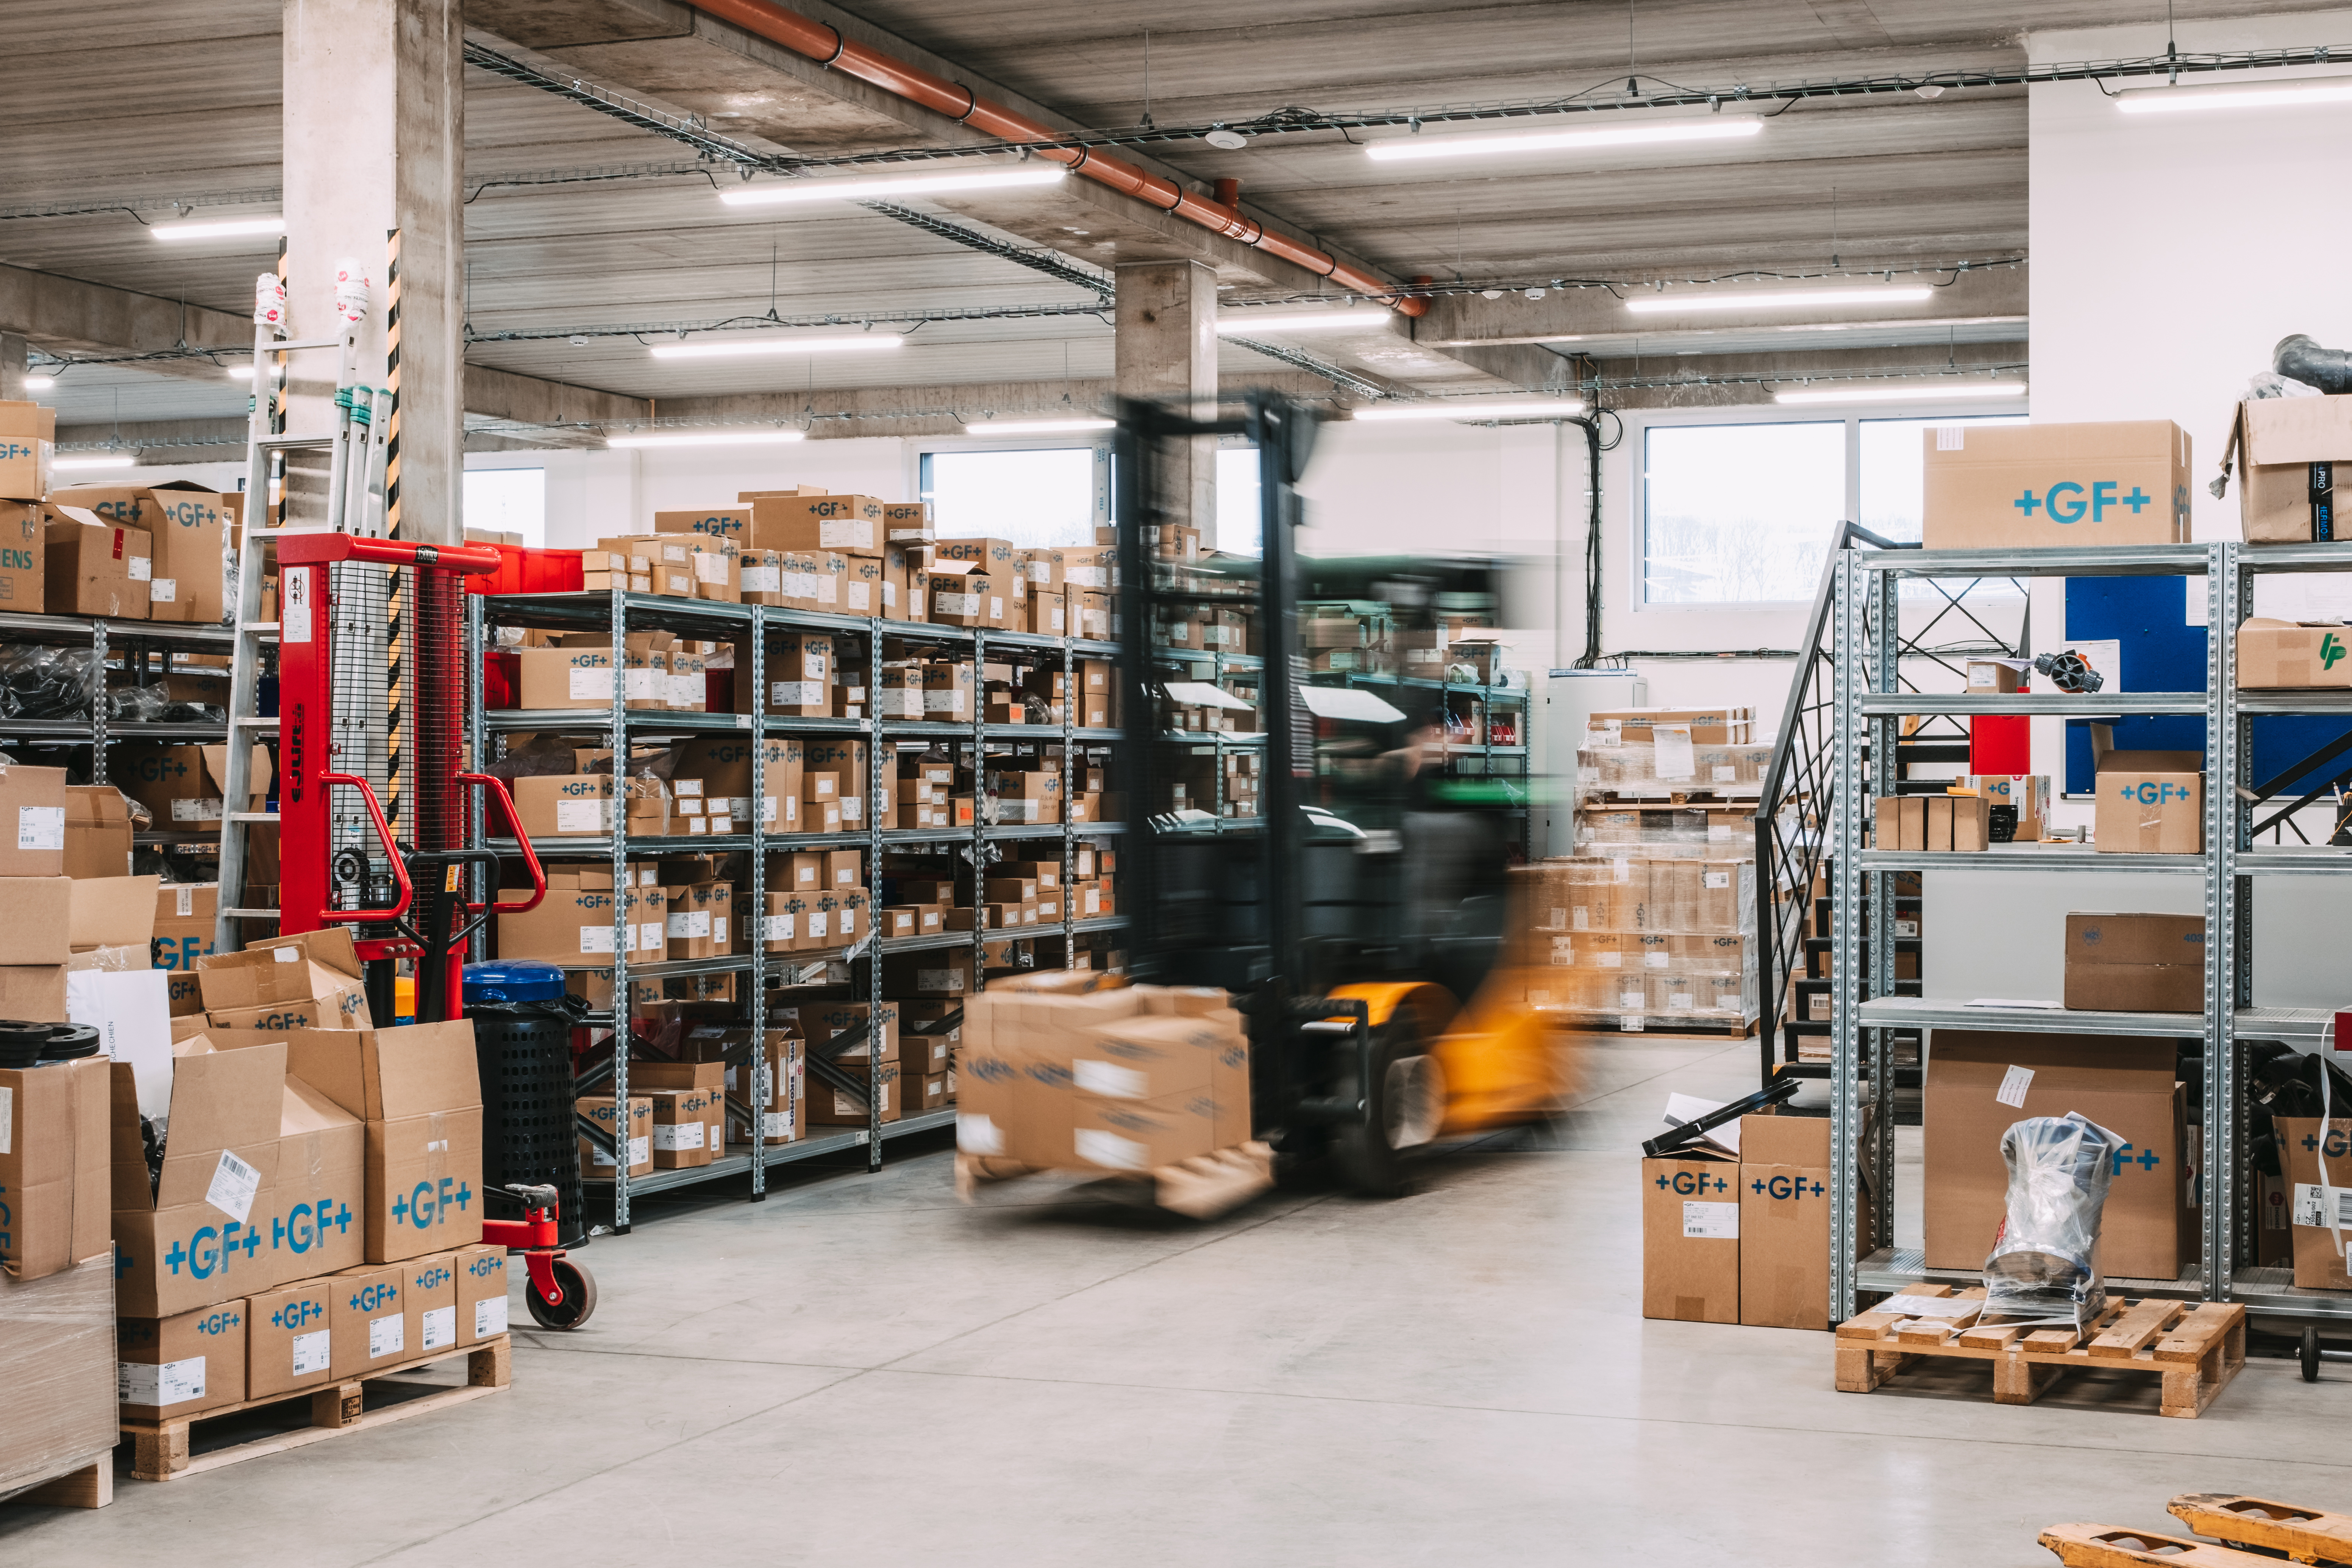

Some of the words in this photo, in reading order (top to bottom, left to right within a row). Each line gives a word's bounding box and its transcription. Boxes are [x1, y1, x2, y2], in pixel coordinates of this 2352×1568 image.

[0, 444, 31, 459] GF+
[2014, 481, 2151, 524] +GF+
[166, 502, 216, 527] +GF+
[863, 504, 881, 518] +GF+
[887, 508, 918, 519] +GF+
[693, 517, 742, 535] +GF+
[720, 545, 739, 561] +GF+
[942, 545, 981, 559] +GF+
[992, 546, 1011, 561] +GF+
[1053, 554, 1063, 562] +GF+
[0, 549, 33, 570] ENS
[740, 556, 757, 564] F+
[763, 556, 779, 568] +GF+
[783, 558, 799, 570] +GF+
[800, 560, 817, 572] +GF+
[826, 559, 845, 573] +GF+
[1013, 559, 1025, 573] +GF+
[859, 565, 879, 579] +GF+
[929, 577, 959, 591] GF+
[973, 581, 990, 593] +GF+
[804, 640, 829, 654] +GF+
[571, 654, 607, 667] +GF+
[650, 656, 665, 669] +GF+
[673, 657, 689, 670] +GF+
[689, 659, 704, 672] +GF+
[882, 673, 901, 684] GF+
[906, 673, 921, 685] +GF+
[1691, 716, 1721, 726] +GF+
[764, 747, 785, 763] +GF+
[787, 747, 801, 763] GF+
[882, 750, 894, 765] GF+
[127, 757, 187, 781] +GF+
[562, 782, 596, 795] +GF+
[2121, 782, 2190, 804] +GF+
[1896, 871, 1922, 889] GF+
[576, 895, 611, 908] +GF+
[625, 895, 638, 907] GF+
[646, 893, 664, 906] +GF+
[693, 890, 712, 903] +GF+
[715, 889, 729, 901] GF+
[844, 895, 865, 909] +GF+
[784, 900, 806, 914] +GF+
[817, 897, 838, 912] +GF+
[1640, 936, 1664, 945] +GF+
[1713, 938, 1738, 946] +GF+
[1711, 978, 1736, 987] +GF+
[168, 982, 195, 1000] GF+
[882, 1009, 896, 1023] GF+
[633, 1106, 650, 1118] +GF+
[652, 1100, 672, 1112] GF+
[682, 1099, 707, 1111] +GF+
[589, 1107, 616, 1121] +GF
[2113, 1143, 2159, 1176] F+
[1656, 1171, 1728, 1195] +GF+
[1752, 1176, 1825, 1200] +GF+
[392, 1177, 472, 1229] +GF+
[272, 1198, 352, 1254] +GF+
[2305, 1216, 2311, 1225] CZ
[165, 1222, 261, 1279] +GF+
[469, 1257, 503, 1277] +GF+
[416, 1268, 450, 1289] +GF+
[350, 1284, 397, 1312] +GF+
[272, 1300, 323, 1329] +GF+
[198, 1313, 240, 1335] +GF+
